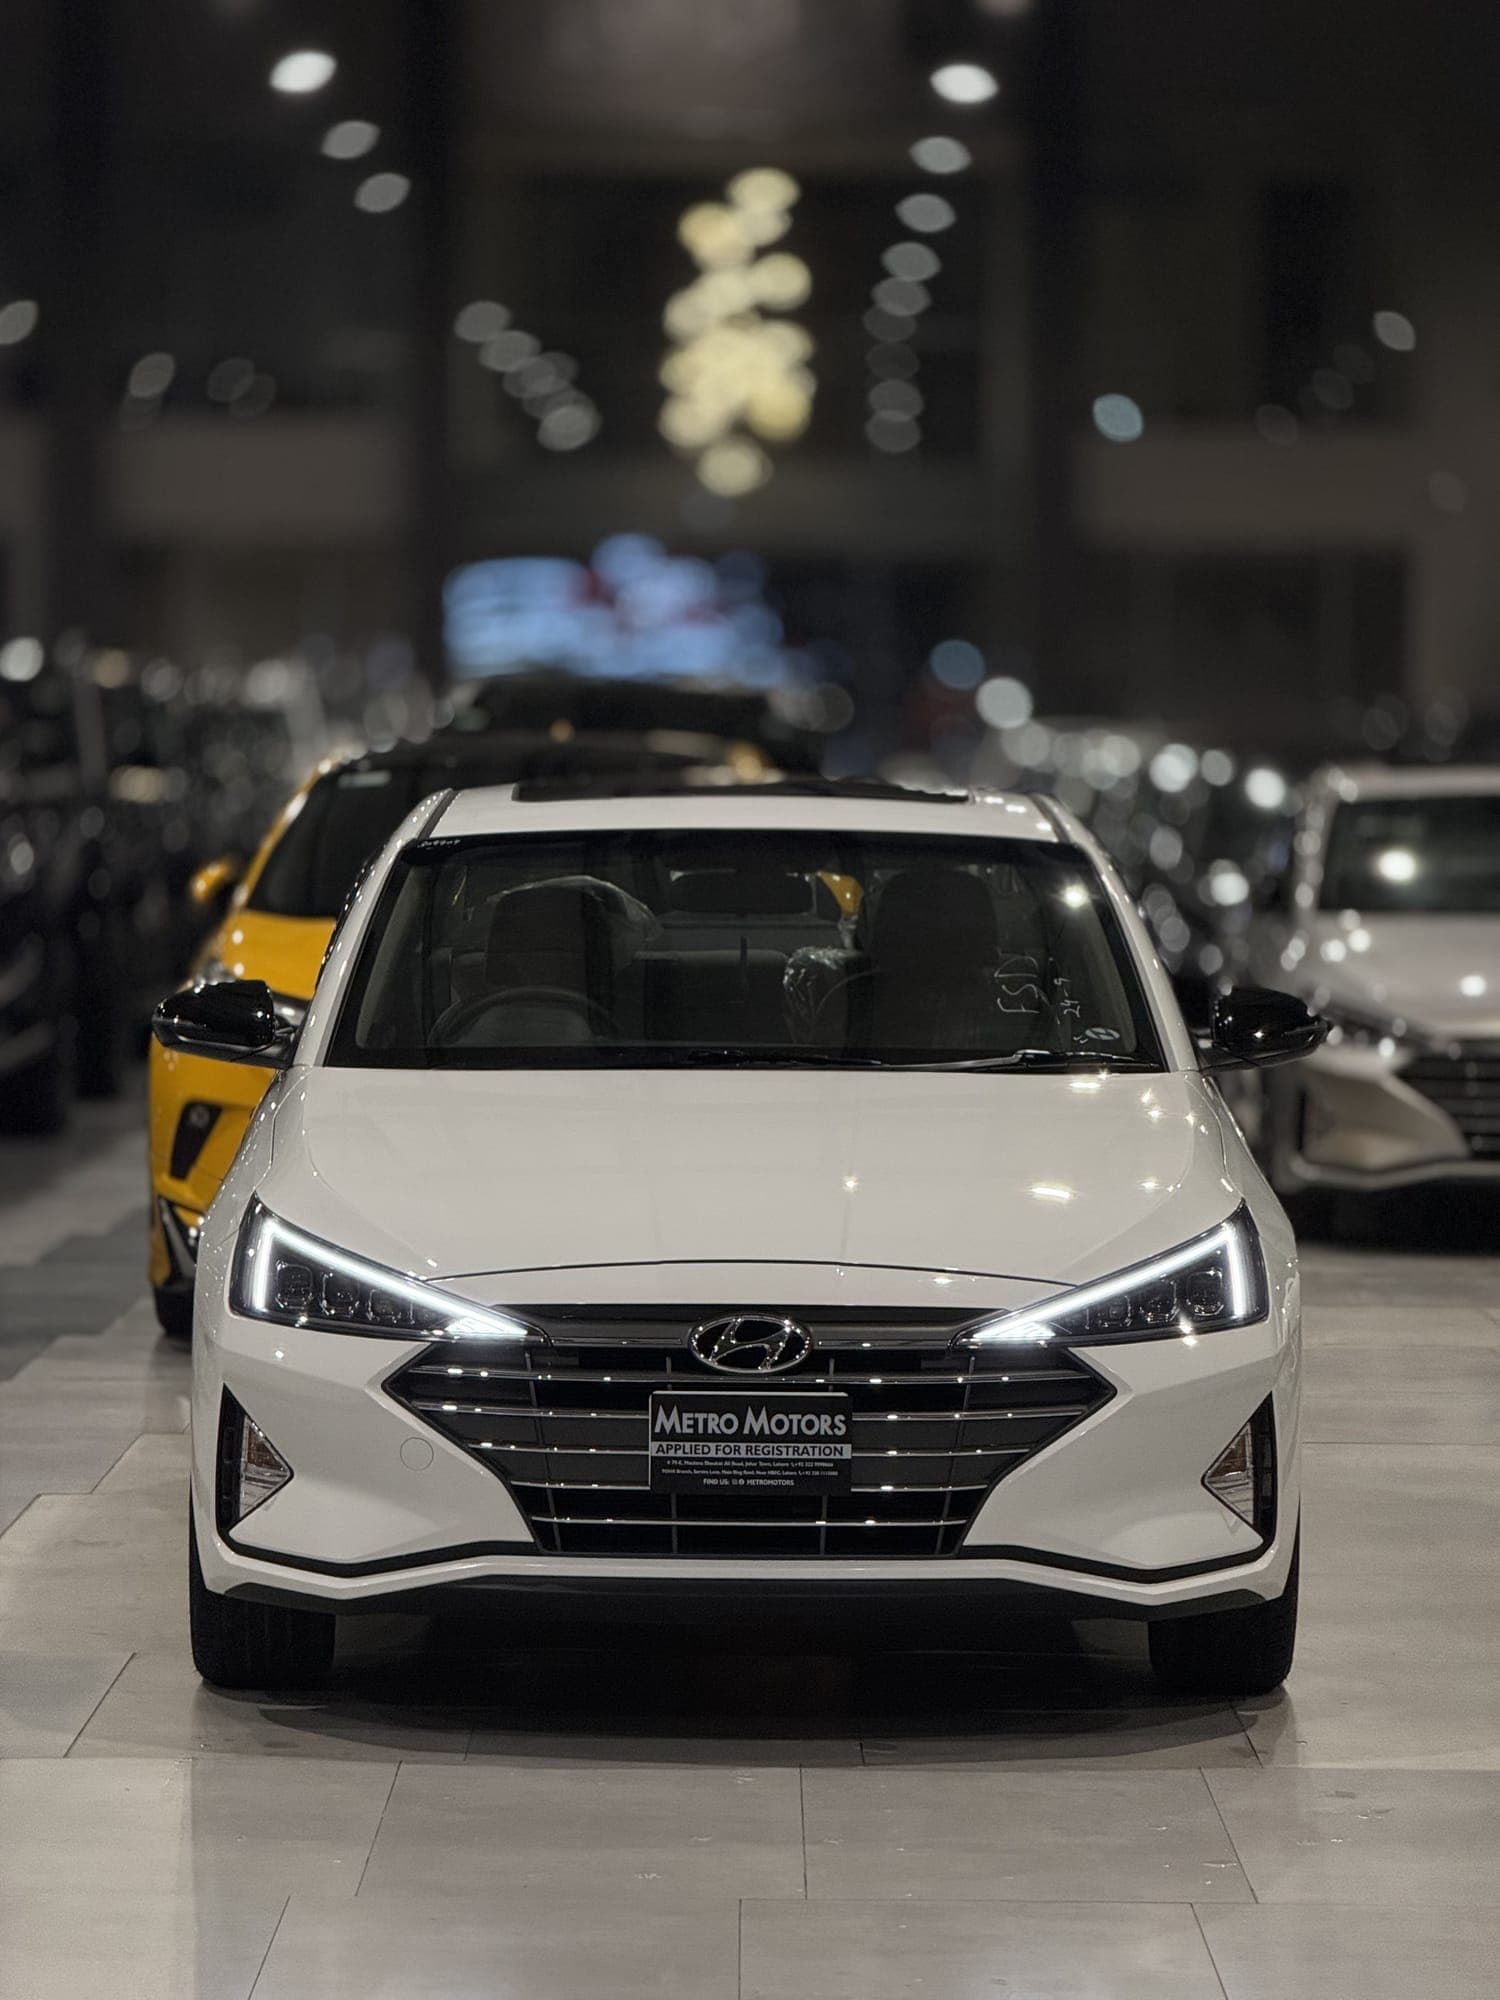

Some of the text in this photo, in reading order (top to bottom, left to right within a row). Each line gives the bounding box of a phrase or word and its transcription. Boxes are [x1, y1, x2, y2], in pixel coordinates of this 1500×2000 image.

[654, 1404, 847, 1437] METRO MOTORS
[655, 1443, 844, 1457] APPLIED FOR REGISTRATION
[703, 1478, 718, 1486] FIND
[746, 1478, 795, 1487] METROMOTORS
